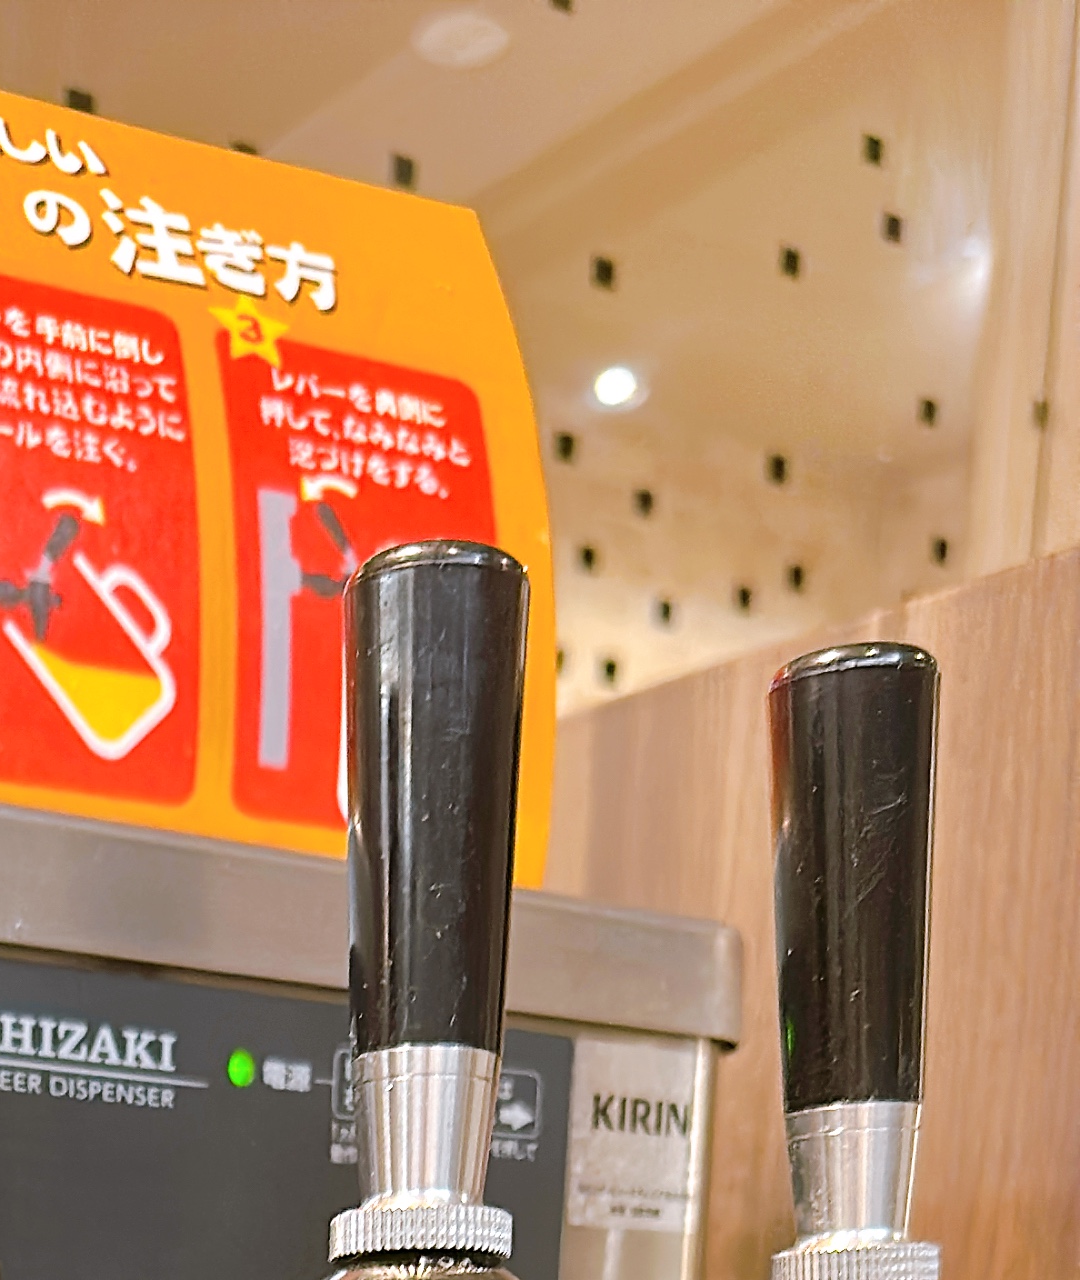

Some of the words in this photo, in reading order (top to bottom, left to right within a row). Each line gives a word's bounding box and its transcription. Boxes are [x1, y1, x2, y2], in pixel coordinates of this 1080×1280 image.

[237, 314, 263, 344] 3
[49, 1074, 176, 1109] DISPENSER
[591, 1092, 688, 1136] KIRIN
